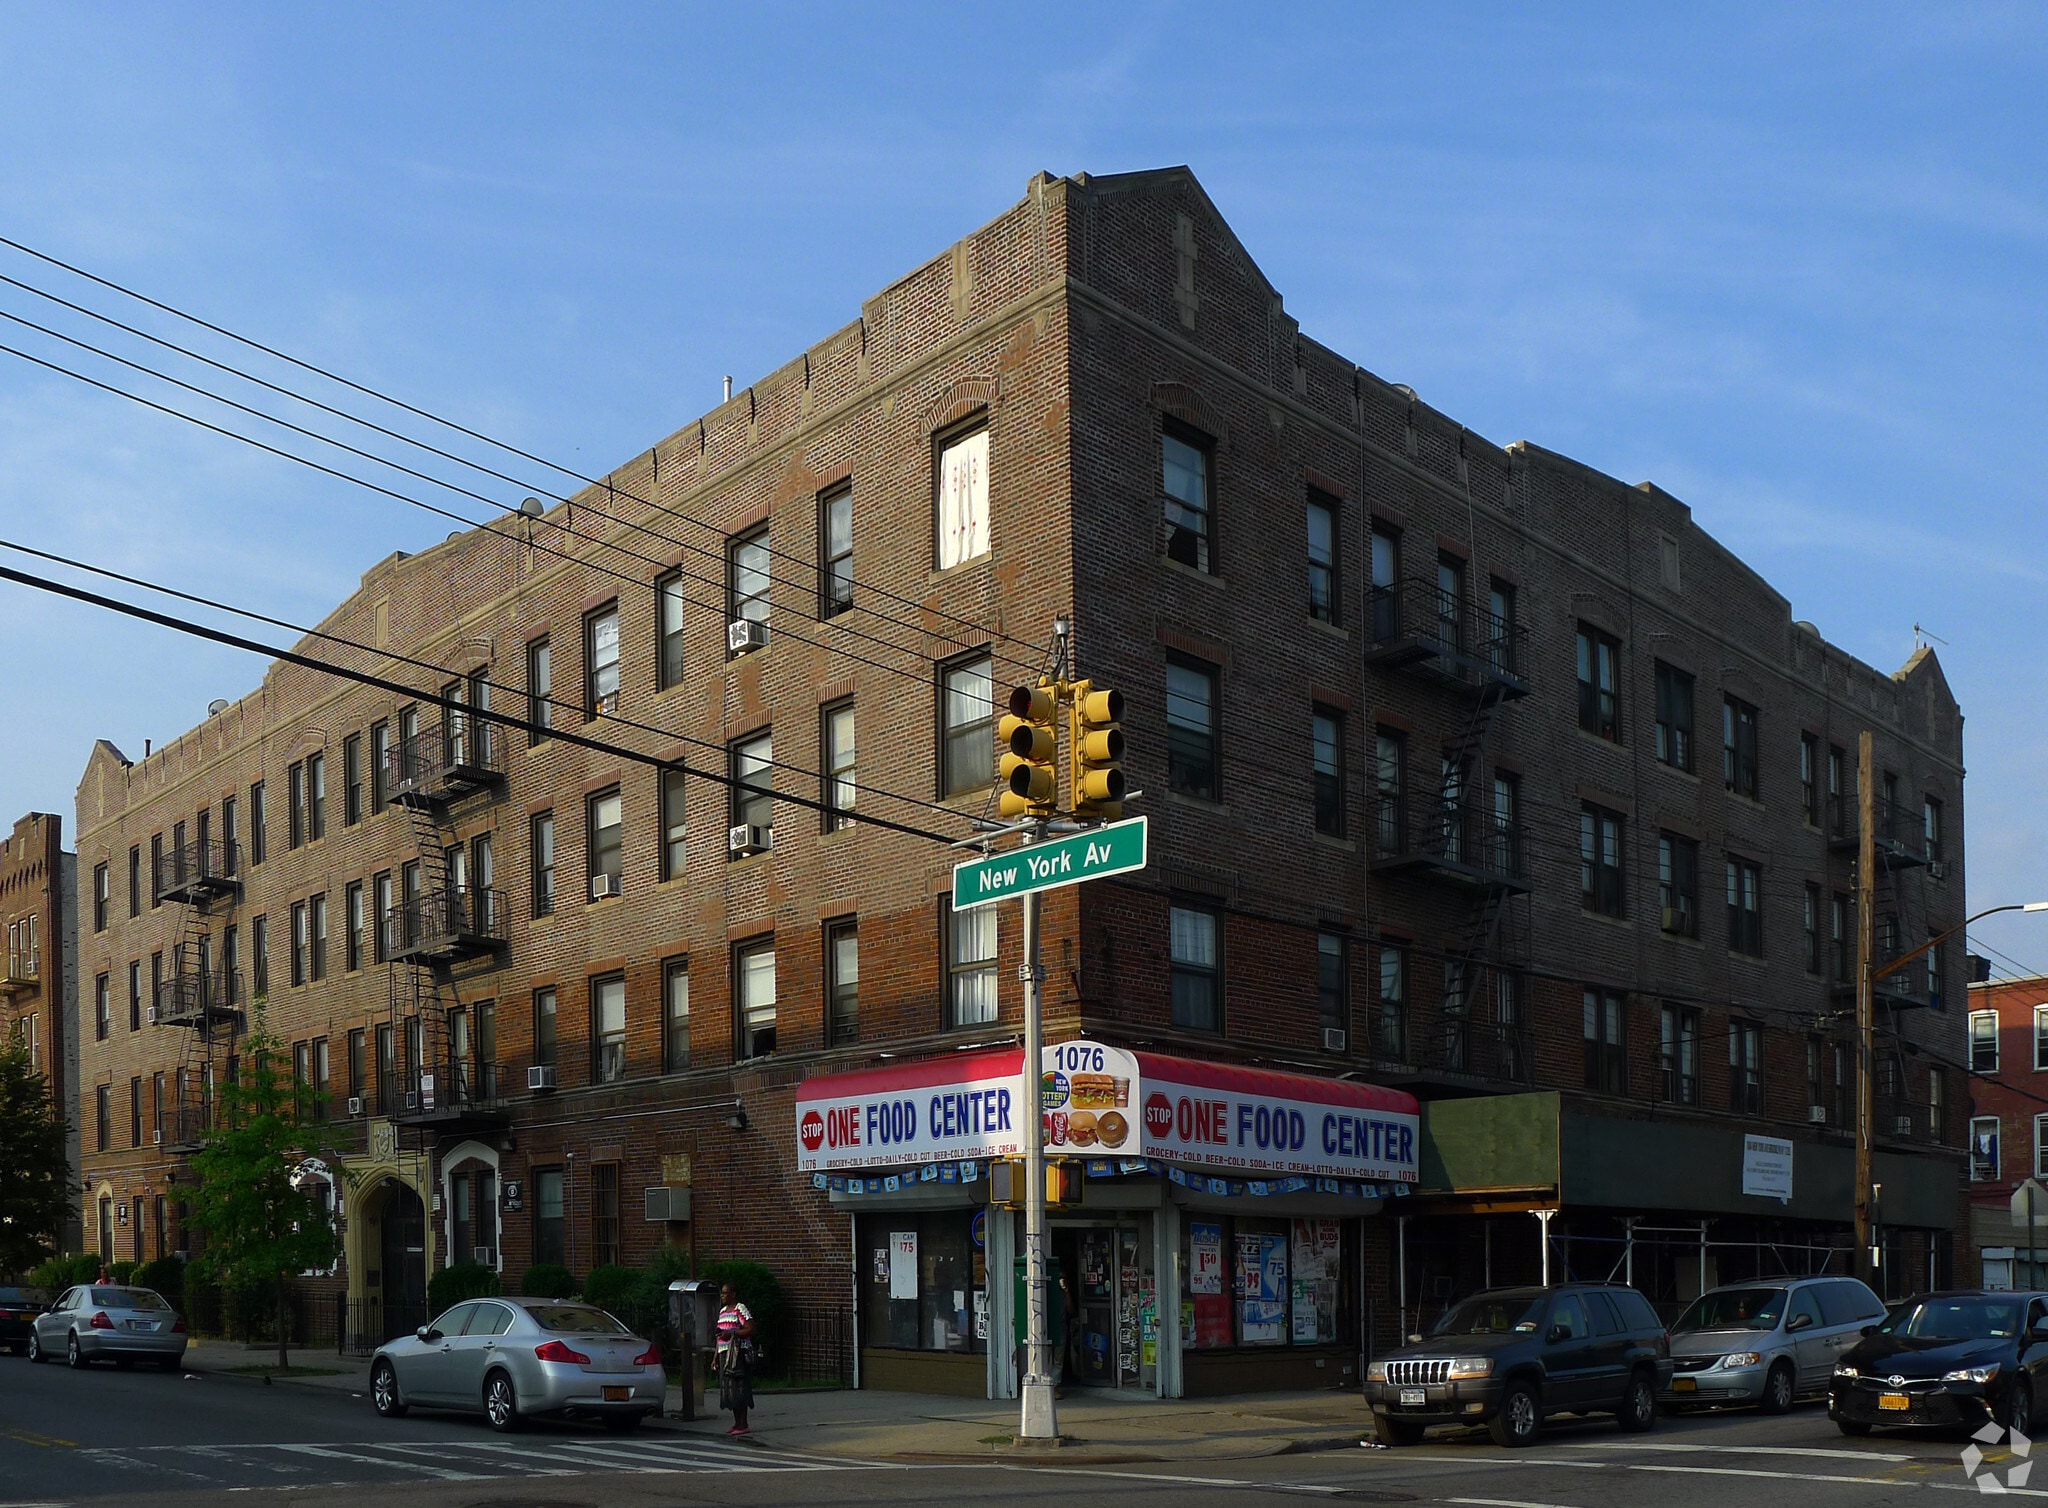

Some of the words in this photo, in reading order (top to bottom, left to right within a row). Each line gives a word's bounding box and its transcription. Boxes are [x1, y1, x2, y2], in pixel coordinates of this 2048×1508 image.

[979, 867, 1018, 892] New
[1027, 849, 1071, 880] York
[1083, 842, 1112, 868] Av
[1054, 1046, 1105, 1072] 1076
[1042, 1091, 1067, 1101] OTTERY
[827, 1105, 860, 1150] ONE
[866, 1099, 917, 1146] FOOD
[930, 1087, 1012, 1140] CENTER
[1146, 1106, 1172, 1124] STOP
[802, 1122, 823, 1138] STOP
[1177, 1096, 1228, 1145] ONE
[1237, 1103, 1305, 1152] FOOD
[1322, 1112, 1414, 1165] CENTER
[802, 1159, 817, 1170] 1076
[921, 1151, 931, 1160] CUT
[999, 1143, 1018, 1154] CREAM
[1378, 1170, 1390, 1179] CUT
[1398, 1170, 1417, 1181] 1076
[1320, 1233, 1339, 1241] BUDS
